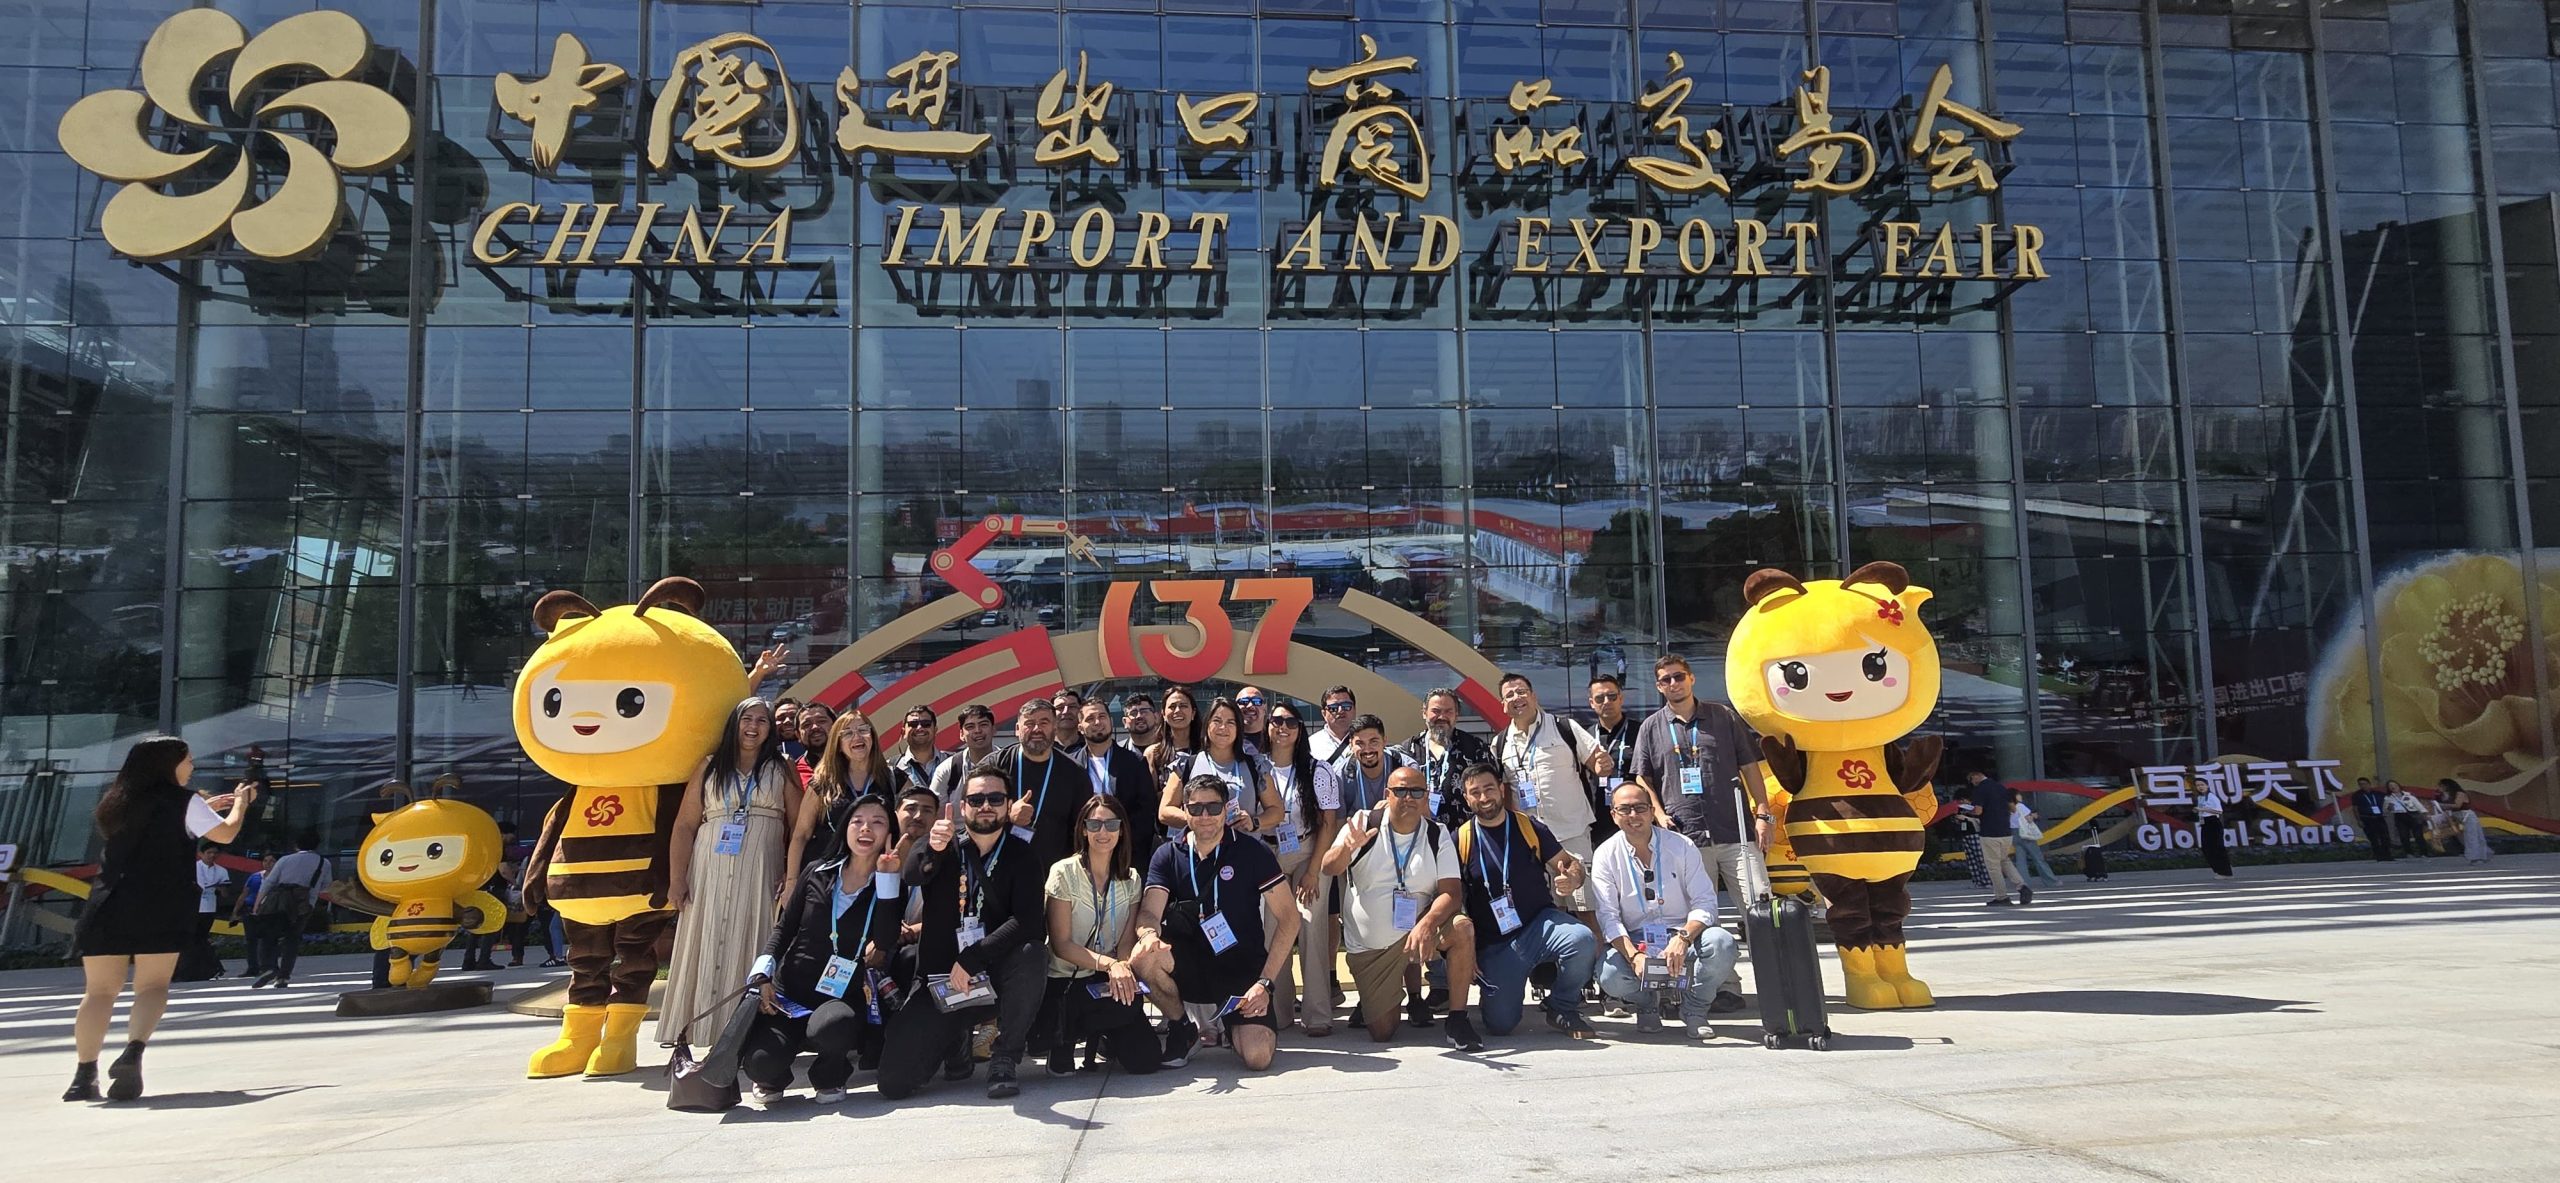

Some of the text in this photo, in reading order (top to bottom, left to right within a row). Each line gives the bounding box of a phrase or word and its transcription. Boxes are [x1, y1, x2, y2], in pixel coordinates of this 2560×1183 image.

[472, 202, 2052, 280] CHINA IMPORT AND EXPORT FAIR
[1099, 578, 1313, 683] 137
[2141, 760, 2344, 806] 互利天下
[2259, 818, 2355, 846] Share
